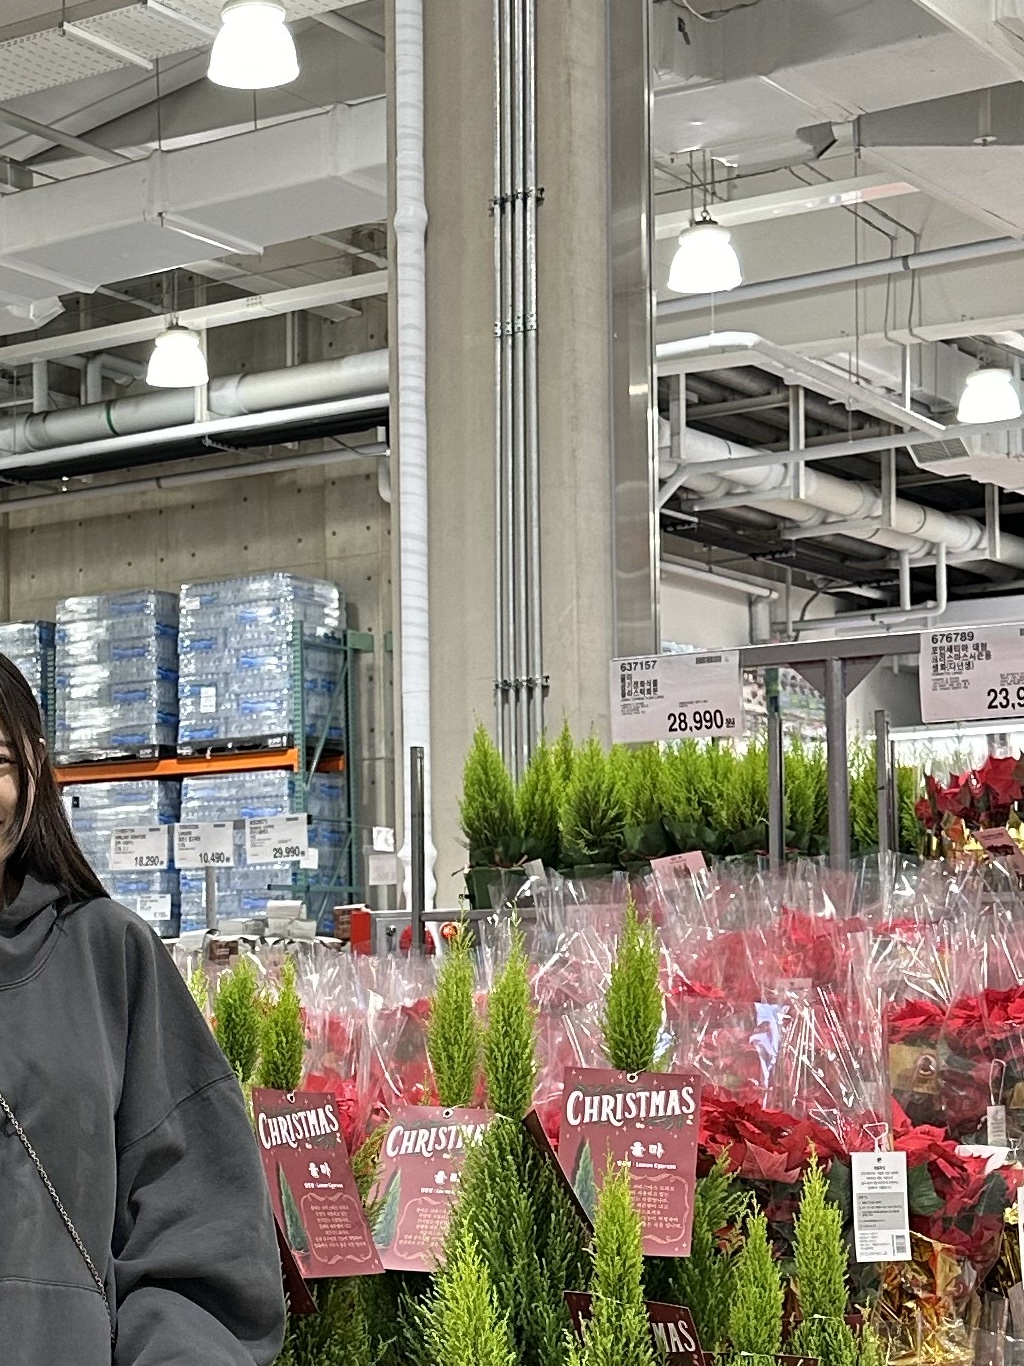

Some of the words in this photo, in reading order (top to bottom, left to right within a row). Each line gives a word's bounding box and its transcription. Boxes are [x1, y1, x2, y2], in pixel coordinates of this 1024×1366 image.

[931, 631, 974, 644] 676789
[620, 660, 657, 672] 637157
[566, 1086, 696, 1126] CHRISTMAS
[258, 1104, 339, 1149] CHRISTMAS
[386, 1124, 490, 1157] CHRISTMA
